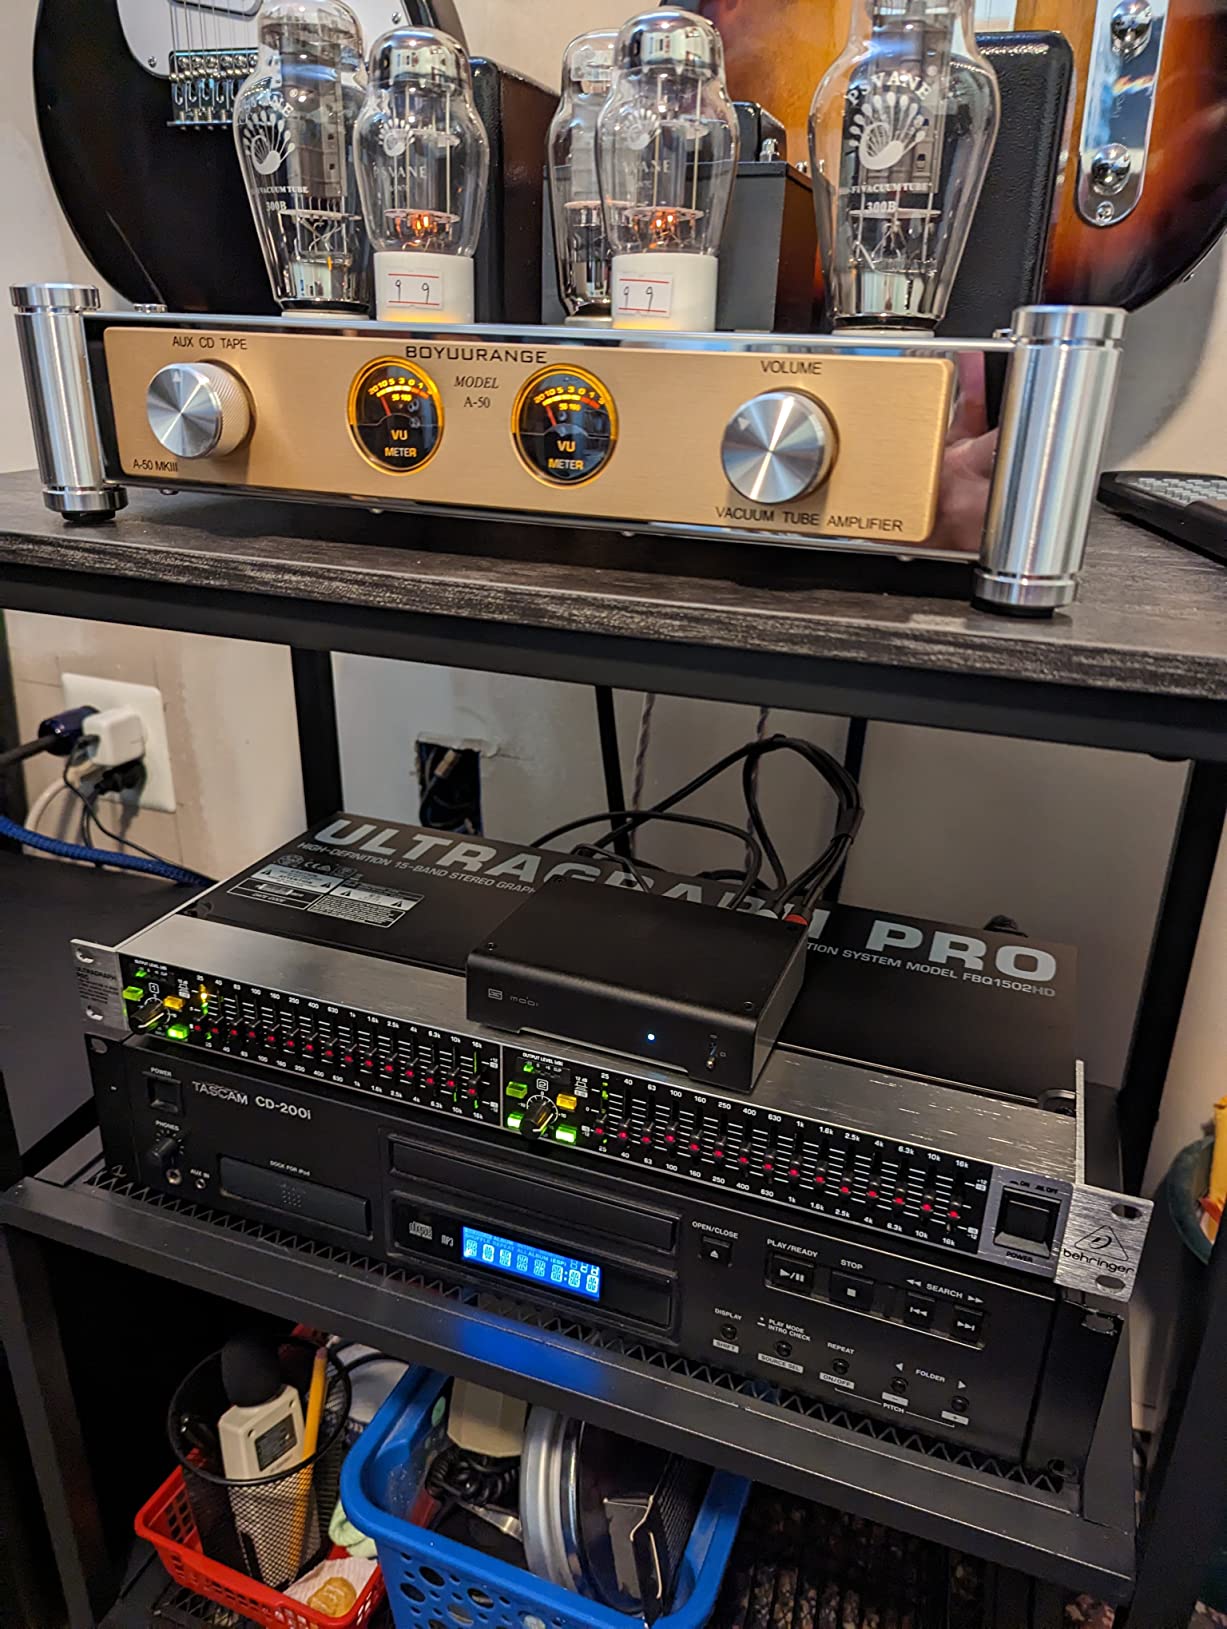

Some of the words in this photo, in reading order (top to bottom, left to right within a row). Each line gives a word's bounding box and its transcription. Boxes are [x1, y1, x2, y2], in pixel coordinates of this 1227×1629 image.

[265, 201, 287, 213] 300B
[172, 336, 194, 348] AUX
[199, 337, 215, 349] CD
[219, 338, 248, 350] TAPE
[405, 345, 548, 364] BOYUURANGE
[760, 360, 822, 375] VOLUME
[453, 376, 499, 389] MODEL
[544, 388, 556, 397] 10
[556, 386, 564, 394] 5
[567, 385, 575, 393] 3
[464, 397, 491, 408] A-50
[391, 429, 408, 440] VU
[384, 447, 417, 457] METER
[557, 440, 575, 452] VU
[133, 458, 153, 471] A-50
[155, 460, 179, 472] MKIII
[548, 458, 584, 470] METER
[715, 506, 775, 522] VACUUM
[782, 511, 820, 526] TUBE
[826, 515, 903, 532] AMPLIFIER
[297, 841, 392, 867] HIGH-DEFINITION
[394, 861, 448, 878] 15-BAND
[449, 869, 494, 887] STEREO
[842, 949, 901, 968] SYSTEM
[906, 962, 958, 979] MODEL
[963, 972, 1056, 998] FBQ1502HD
[865, 919, 1057, 982] PRO
[150, 1067, 172, 1077] POWER
[191, 1081, 248, 1105] TASCAM
[255, 1096, 312, 1120] CD-200i
[600, 1072, 609, 1080] 25
[624, 1078, 633, 1086] 40
[647, 1084, 656, 1092] 63
[670, 1089, 682, 1098] 100
[694, 1095, 707, 1104] 160
[718, 1101, 732, 1110] 250
[743, 1107, 757, 1117] 400
[768, 1113, 782, 1123] 630
[796, 1120, 804, 1128] 1k
[819, 1126, 834, 1136] 1.6k
[844, 1132, 860, 1142] 2.5k
[874, 1140, 884, 1148] 4k
[898, 1145, 915, 1156] 6.3k
[927, 1152, 941, 1162] 10k
[155, 1120, 179, 1131] PHONES
[620, 1151, 630, 1159] 40
[665, 1163, 678, 1171] 100
[689, 1169, 702, 1178] 160
[712, 1175, 725, 1185] 250
[736, 1182, 750, 1191] 400
[760, 1188, 774, 1198] 630
[788, 1196, 796, 1204] 1k
[810, 1202, 825, 1211] 1.6k
[834, 1208, 850, 1218] 2.5k
[863, 1216, 873, 1224] 4k
[915, 1230, 928, 1239] 10k
[692, 1221, 739, 1240] OPEN/CLOSE
[766, 1238, 819, 1258] PLAY/READY
[1006, 1251, 1033, 1262] POWER
[1063, 1248, 1135, 1274] behringer
[840, 1259, 864, 1270] STOP
[926, 1282, 964, 1300] SEARCH
[714, 1308, 742, 1320] DISPLAY
[768, 1319, 784, 1327] PLAY
[785, 1324, 805, 1333] MODE
[768, 1324, 788, 1334] INTRO
[789, 1330, 811, 1342] CHECK
[827, 1341, 855, 1355] REPEAT
[915, 1369, 946, 1383] FOLDER
[883, 1401, 905, 1414] PITCH
